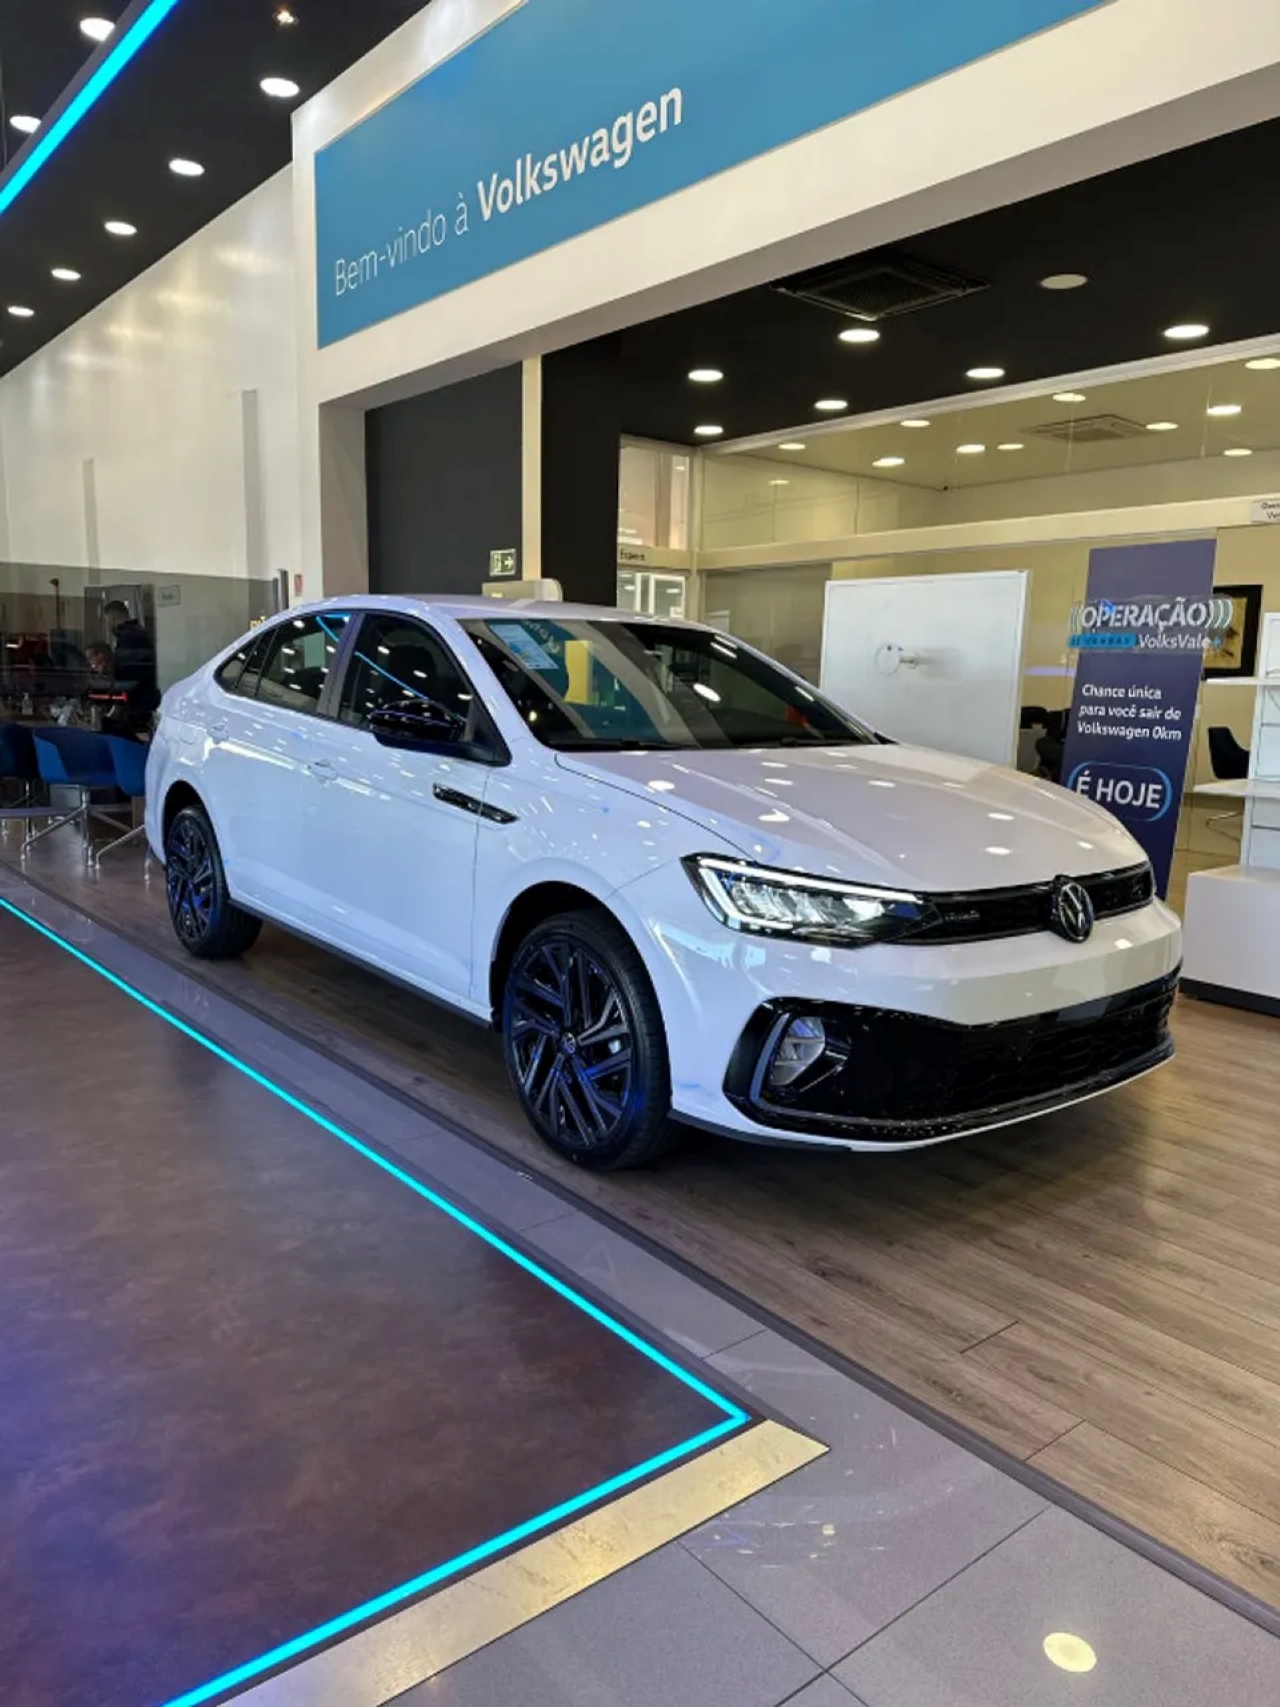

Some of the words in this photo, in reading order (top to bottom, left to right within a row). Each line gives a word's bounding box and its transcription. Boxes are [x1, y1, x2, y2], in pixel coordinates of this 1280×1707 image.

[335, 208, 447, 297] Bem-vindo
[453, 191, 469, 236] à
[476, 86, 683, 222] Volkswagen
[1081, 683, 1126, 698] Chance
[1128, 685, 1162, 700] única
[1078, 705, 1106, 718] para
[1108, 704, 1137, 718] você
[1139, 706, 1163, 719] sair
[1077, 720, 1150, 740] Volkswagen
[1152, 726, 1182, 741] 0km
[1076, 770, 1092, 798] É
[1096, 778, 1163, 809] HOJE
